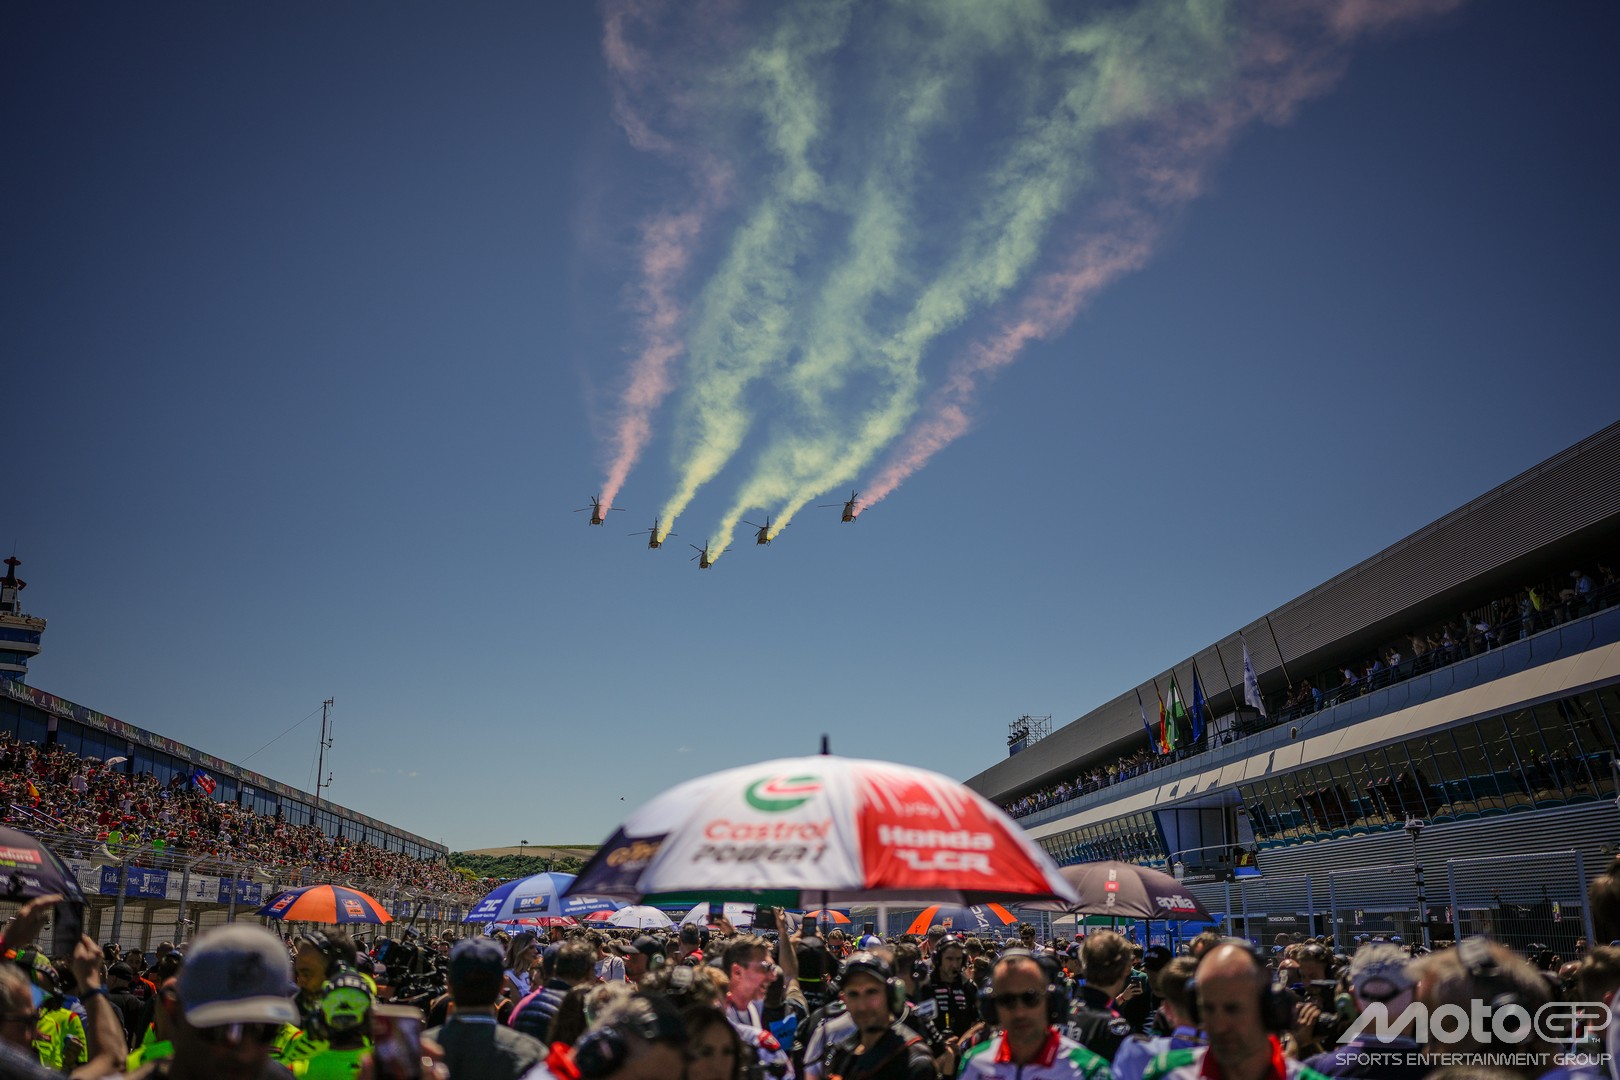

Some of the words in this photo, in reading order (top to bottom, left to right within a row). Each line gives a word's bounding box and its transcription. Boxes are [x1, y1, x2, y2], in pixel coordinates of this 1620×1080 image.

[704, 816, 834, 842] Castrol
[878, 824, 995, 851] Honda
[894, 848, 997, 876] LCR
[1156, 895, 1196, 911] aprilia
